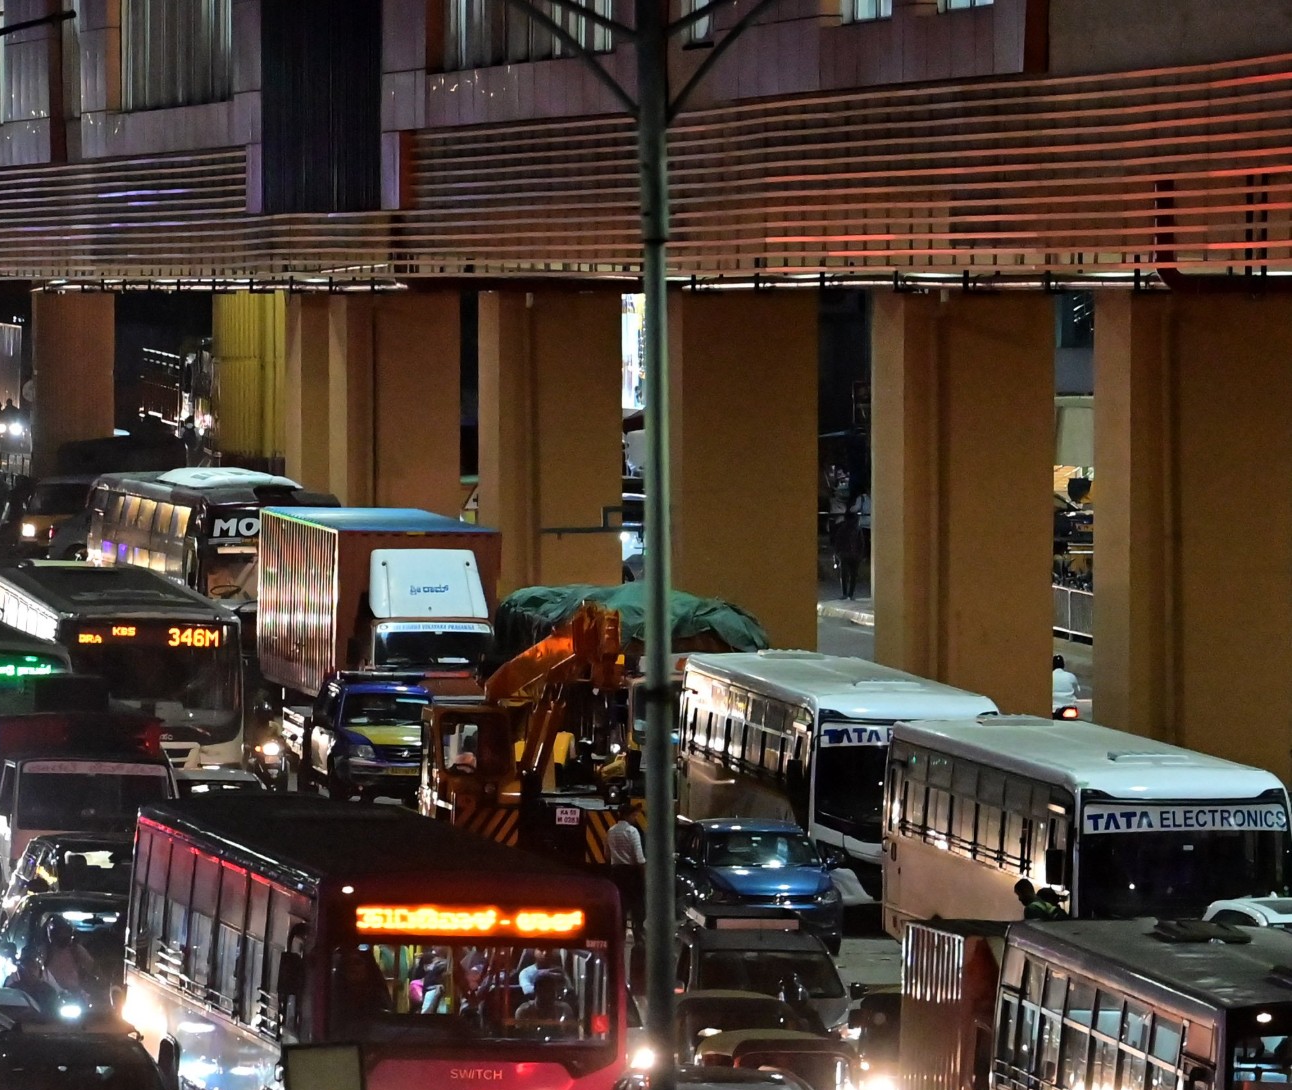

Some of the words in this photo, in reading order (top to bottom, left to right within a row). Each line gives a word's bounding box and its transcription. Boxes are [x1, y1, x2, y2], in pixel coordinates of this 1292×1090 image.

[168, 628, 219, 647] 346M
[824, 728, 881, 744] TATA
[1087, 812, 1153, 831] TATA
[1160, 809, 1286, 830] ELECTRONICS
[450, 1068, 503, 1080] SWITCH
